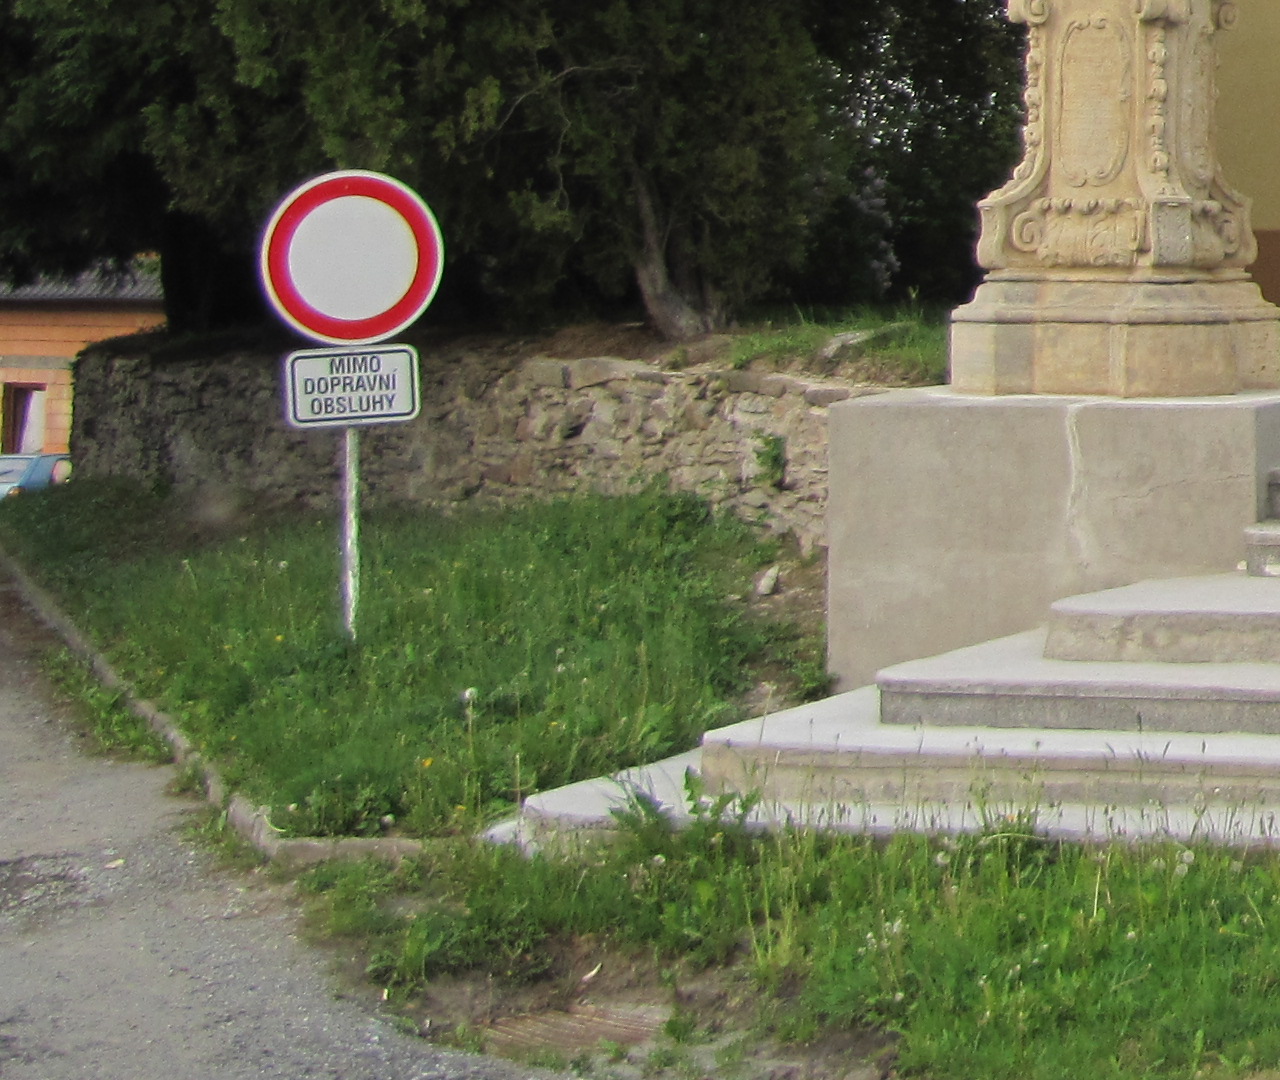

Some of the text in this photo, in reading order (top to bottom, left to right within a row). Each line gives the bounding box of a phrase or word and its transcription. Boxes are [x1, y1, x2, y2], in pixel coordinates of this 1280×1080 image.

[330, 356, 381, 374] MIMO
[305, 368, 397, 395] DOPRAVNÍ
[311, 394, 396, 415] OBSLUHY
